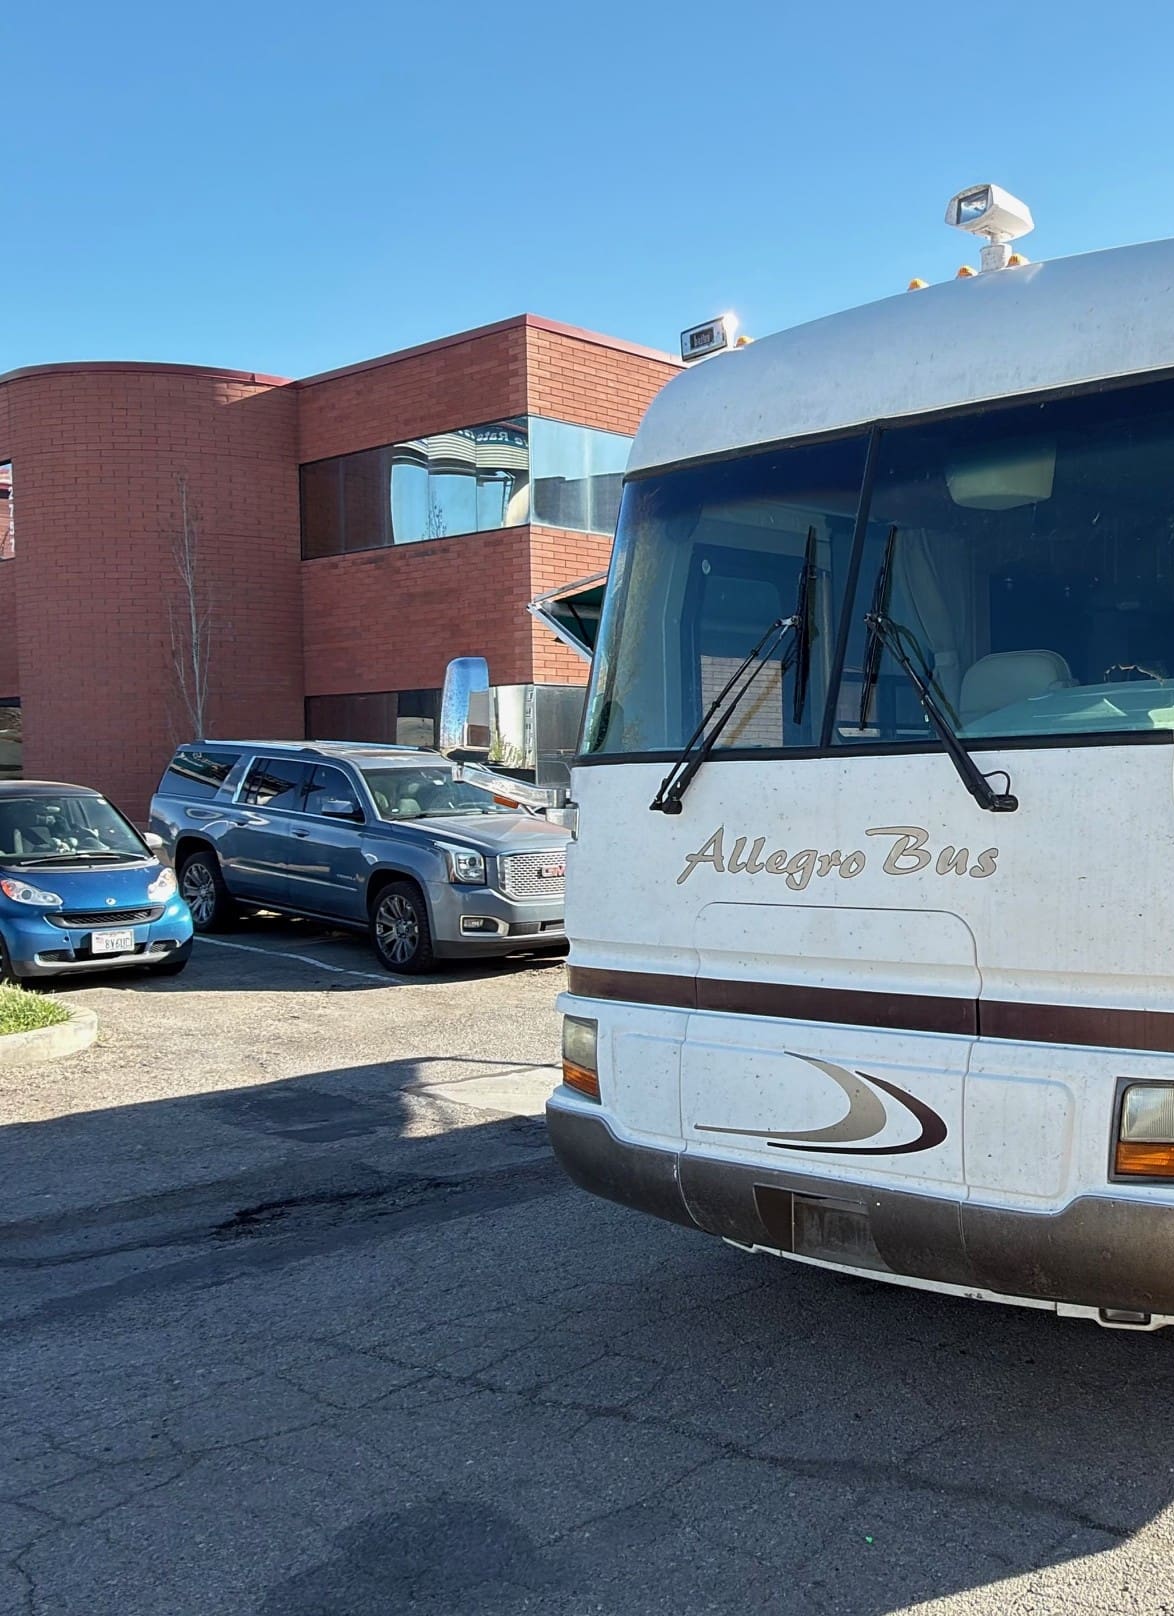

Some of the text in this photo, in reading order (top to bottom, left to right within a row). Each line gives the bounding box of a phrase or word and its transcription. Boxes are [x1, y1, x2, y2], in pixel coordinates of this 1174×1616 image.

[542, 865, 567, 878] GM
[676, 823, 999, 891] Allegro Bus
